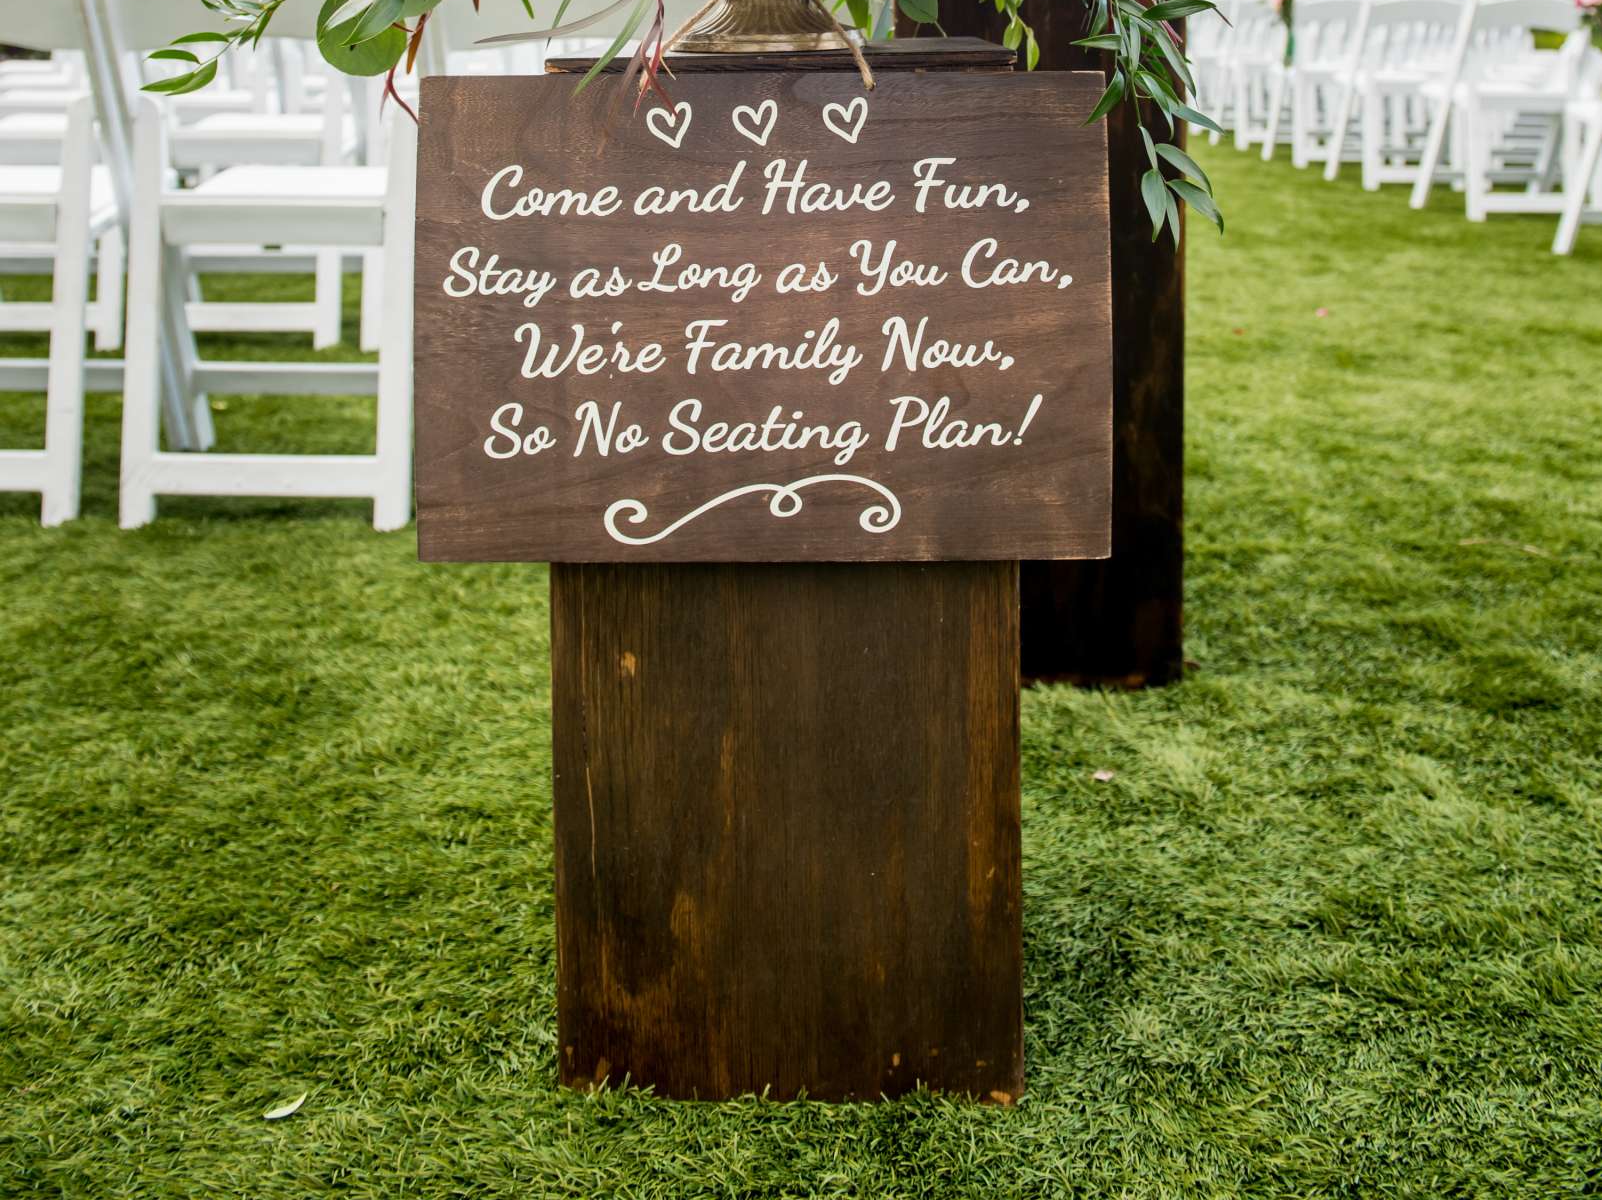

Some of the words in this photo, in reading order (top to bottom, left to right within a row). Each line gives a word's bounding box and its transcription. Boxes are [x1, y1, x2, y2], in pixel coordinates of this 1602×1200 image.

[480, 164, 623, 221] Come
[633, 159, 747, 216] and
[761, 158, 896, 215] Have
[913, 157, 1031, 215] Fun,
[442, 246, 557, 308] Stay
[569, 266, 633, 299] as
[636, 243, 763, 304] Long
[775, 261, 839, 294] as
[849, 239, 949, 297] You
[961, 237, 1074, 291] Can,
[513, 320, 667, 379] We're
[684, 317, 864, 386] Family
[880, 315, 1016, 372] Now,
[483, 402, 557, 460] So
[573, 400, 650, 458] No
[661, 398, 870, 466] Seating
[884, 393, 1044, 453] Plan!
